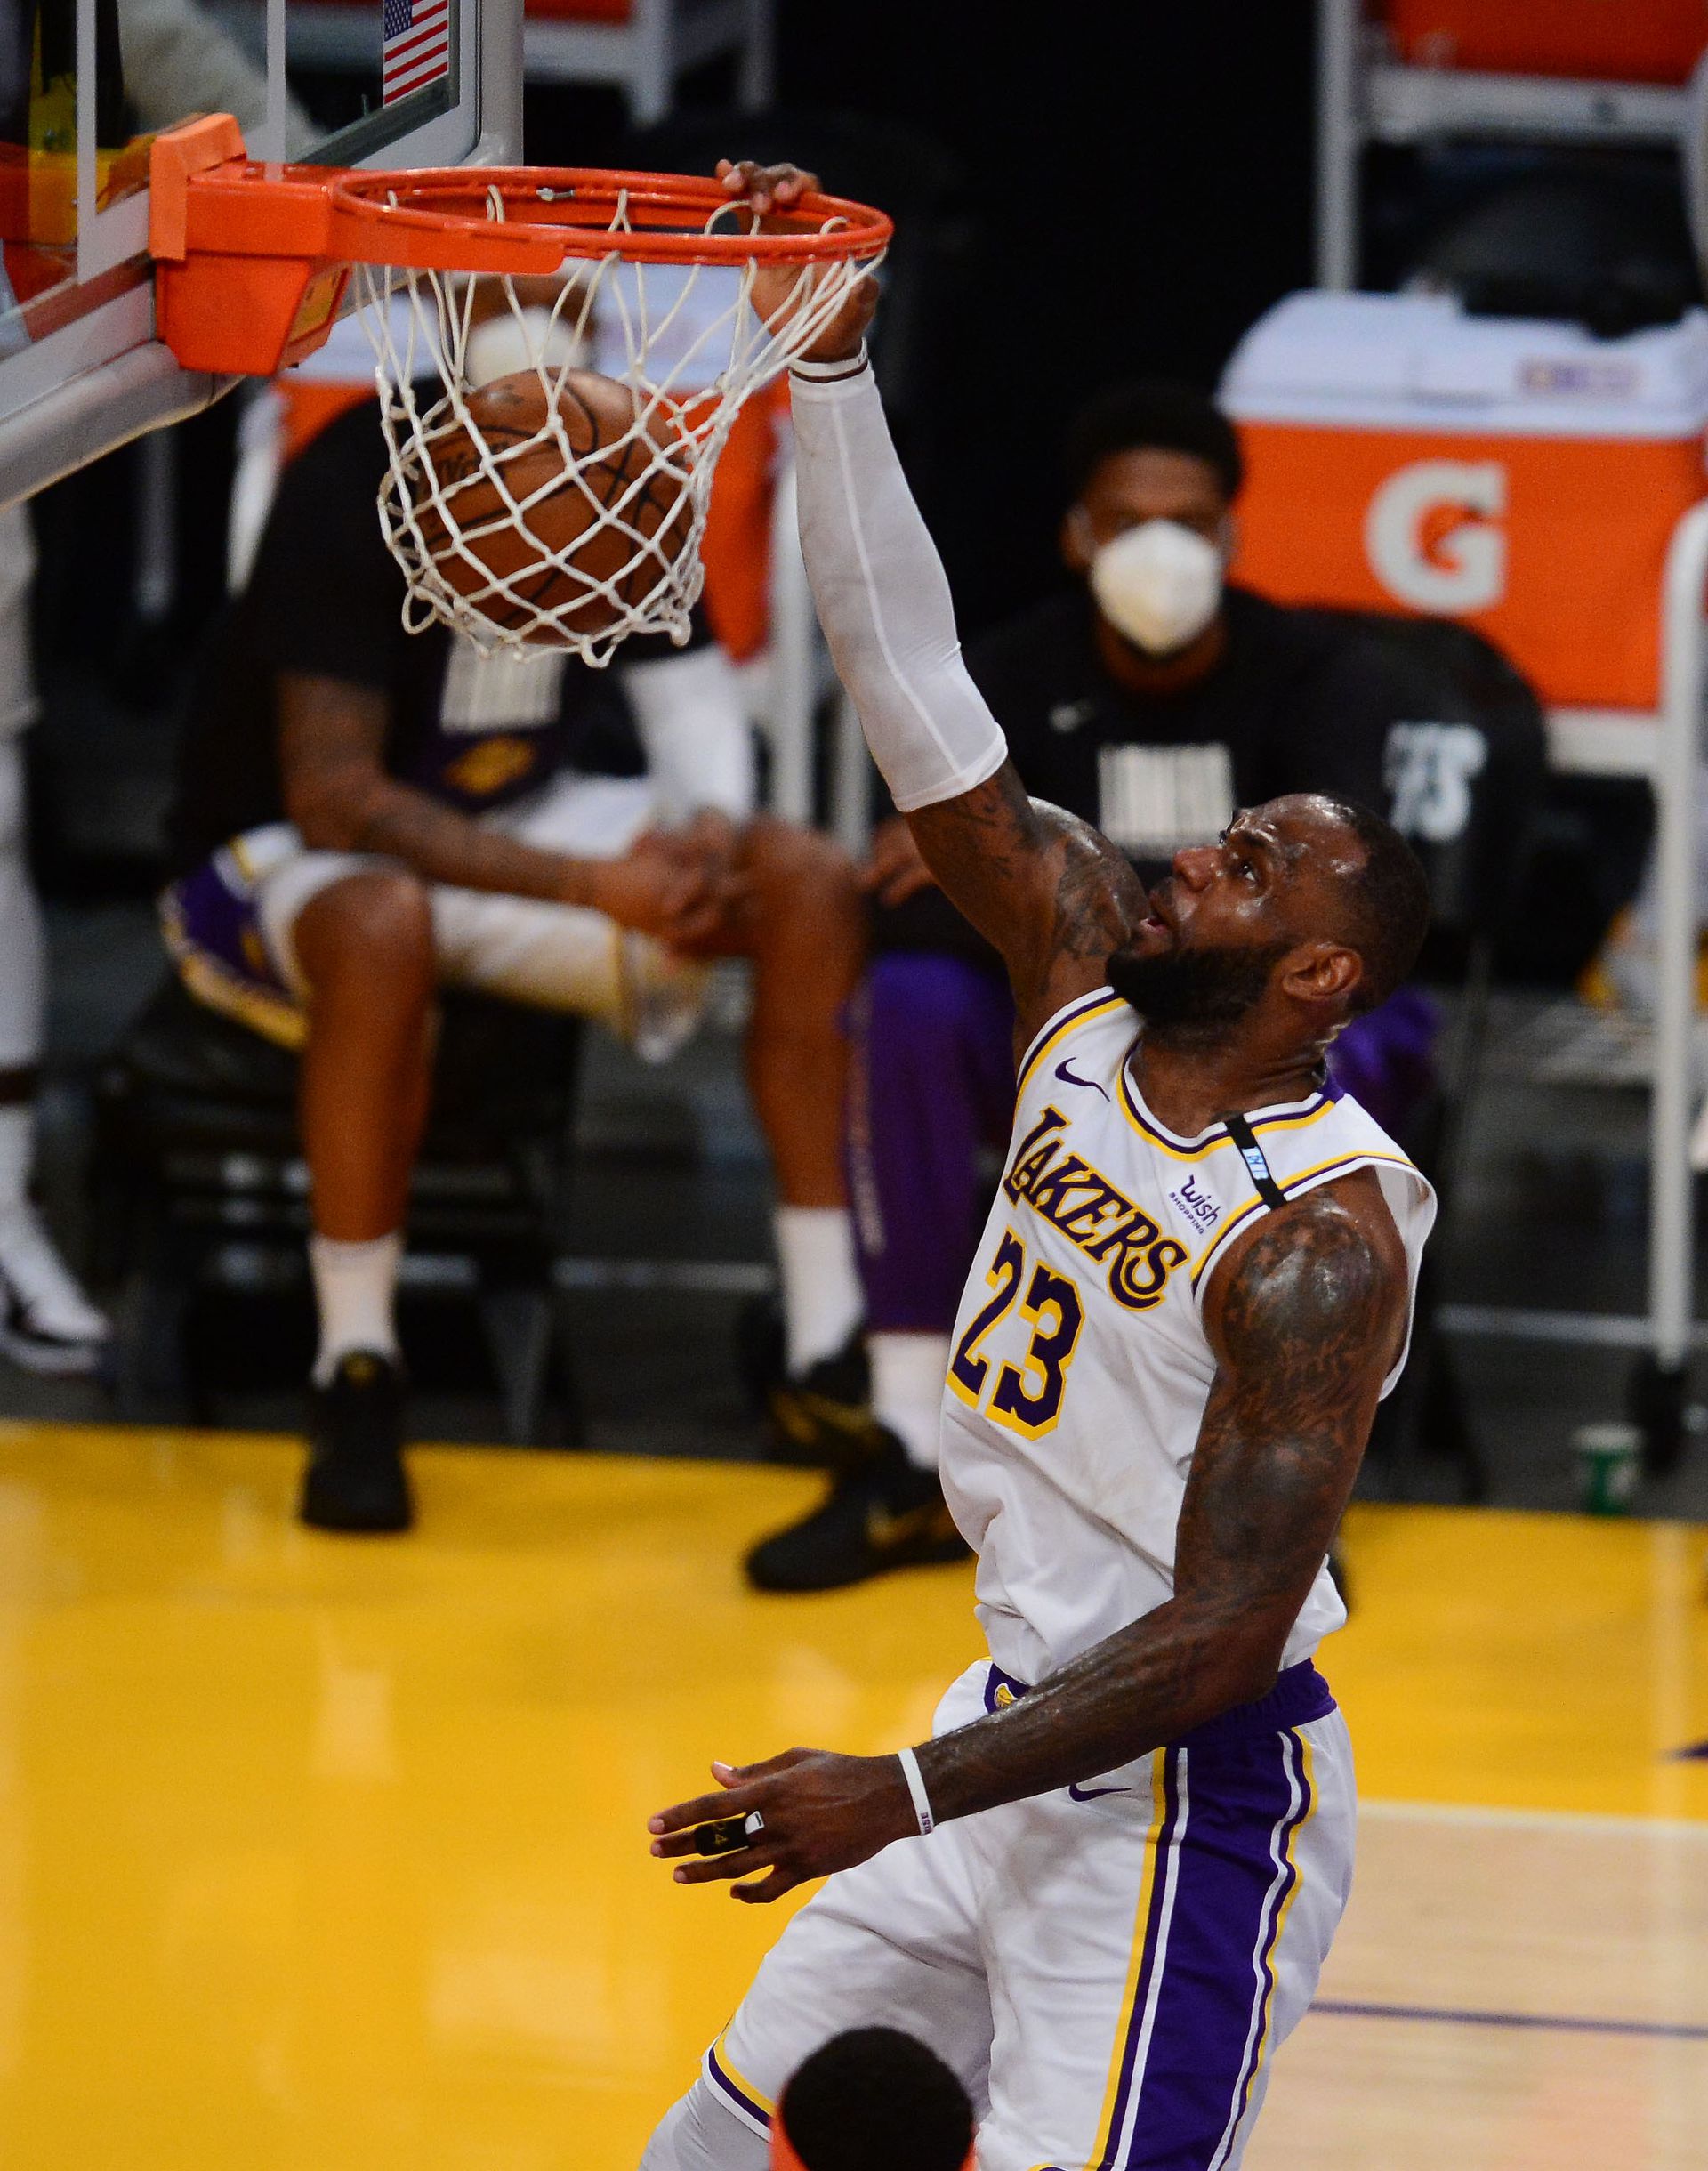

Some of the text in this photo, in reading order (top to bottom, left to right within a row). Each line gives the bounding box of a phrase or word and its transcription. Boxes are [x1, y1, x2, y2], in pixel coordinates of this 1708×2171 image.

[1364, 458, 1509, 617] G
[1003, 1103, 1191, 1311] LAKERS
[1168, 1192, 1204, 1235] SHOPPING
[1181, 1174, 1221, 1227] wish
[946, 1223, 1085, 1441] 23
